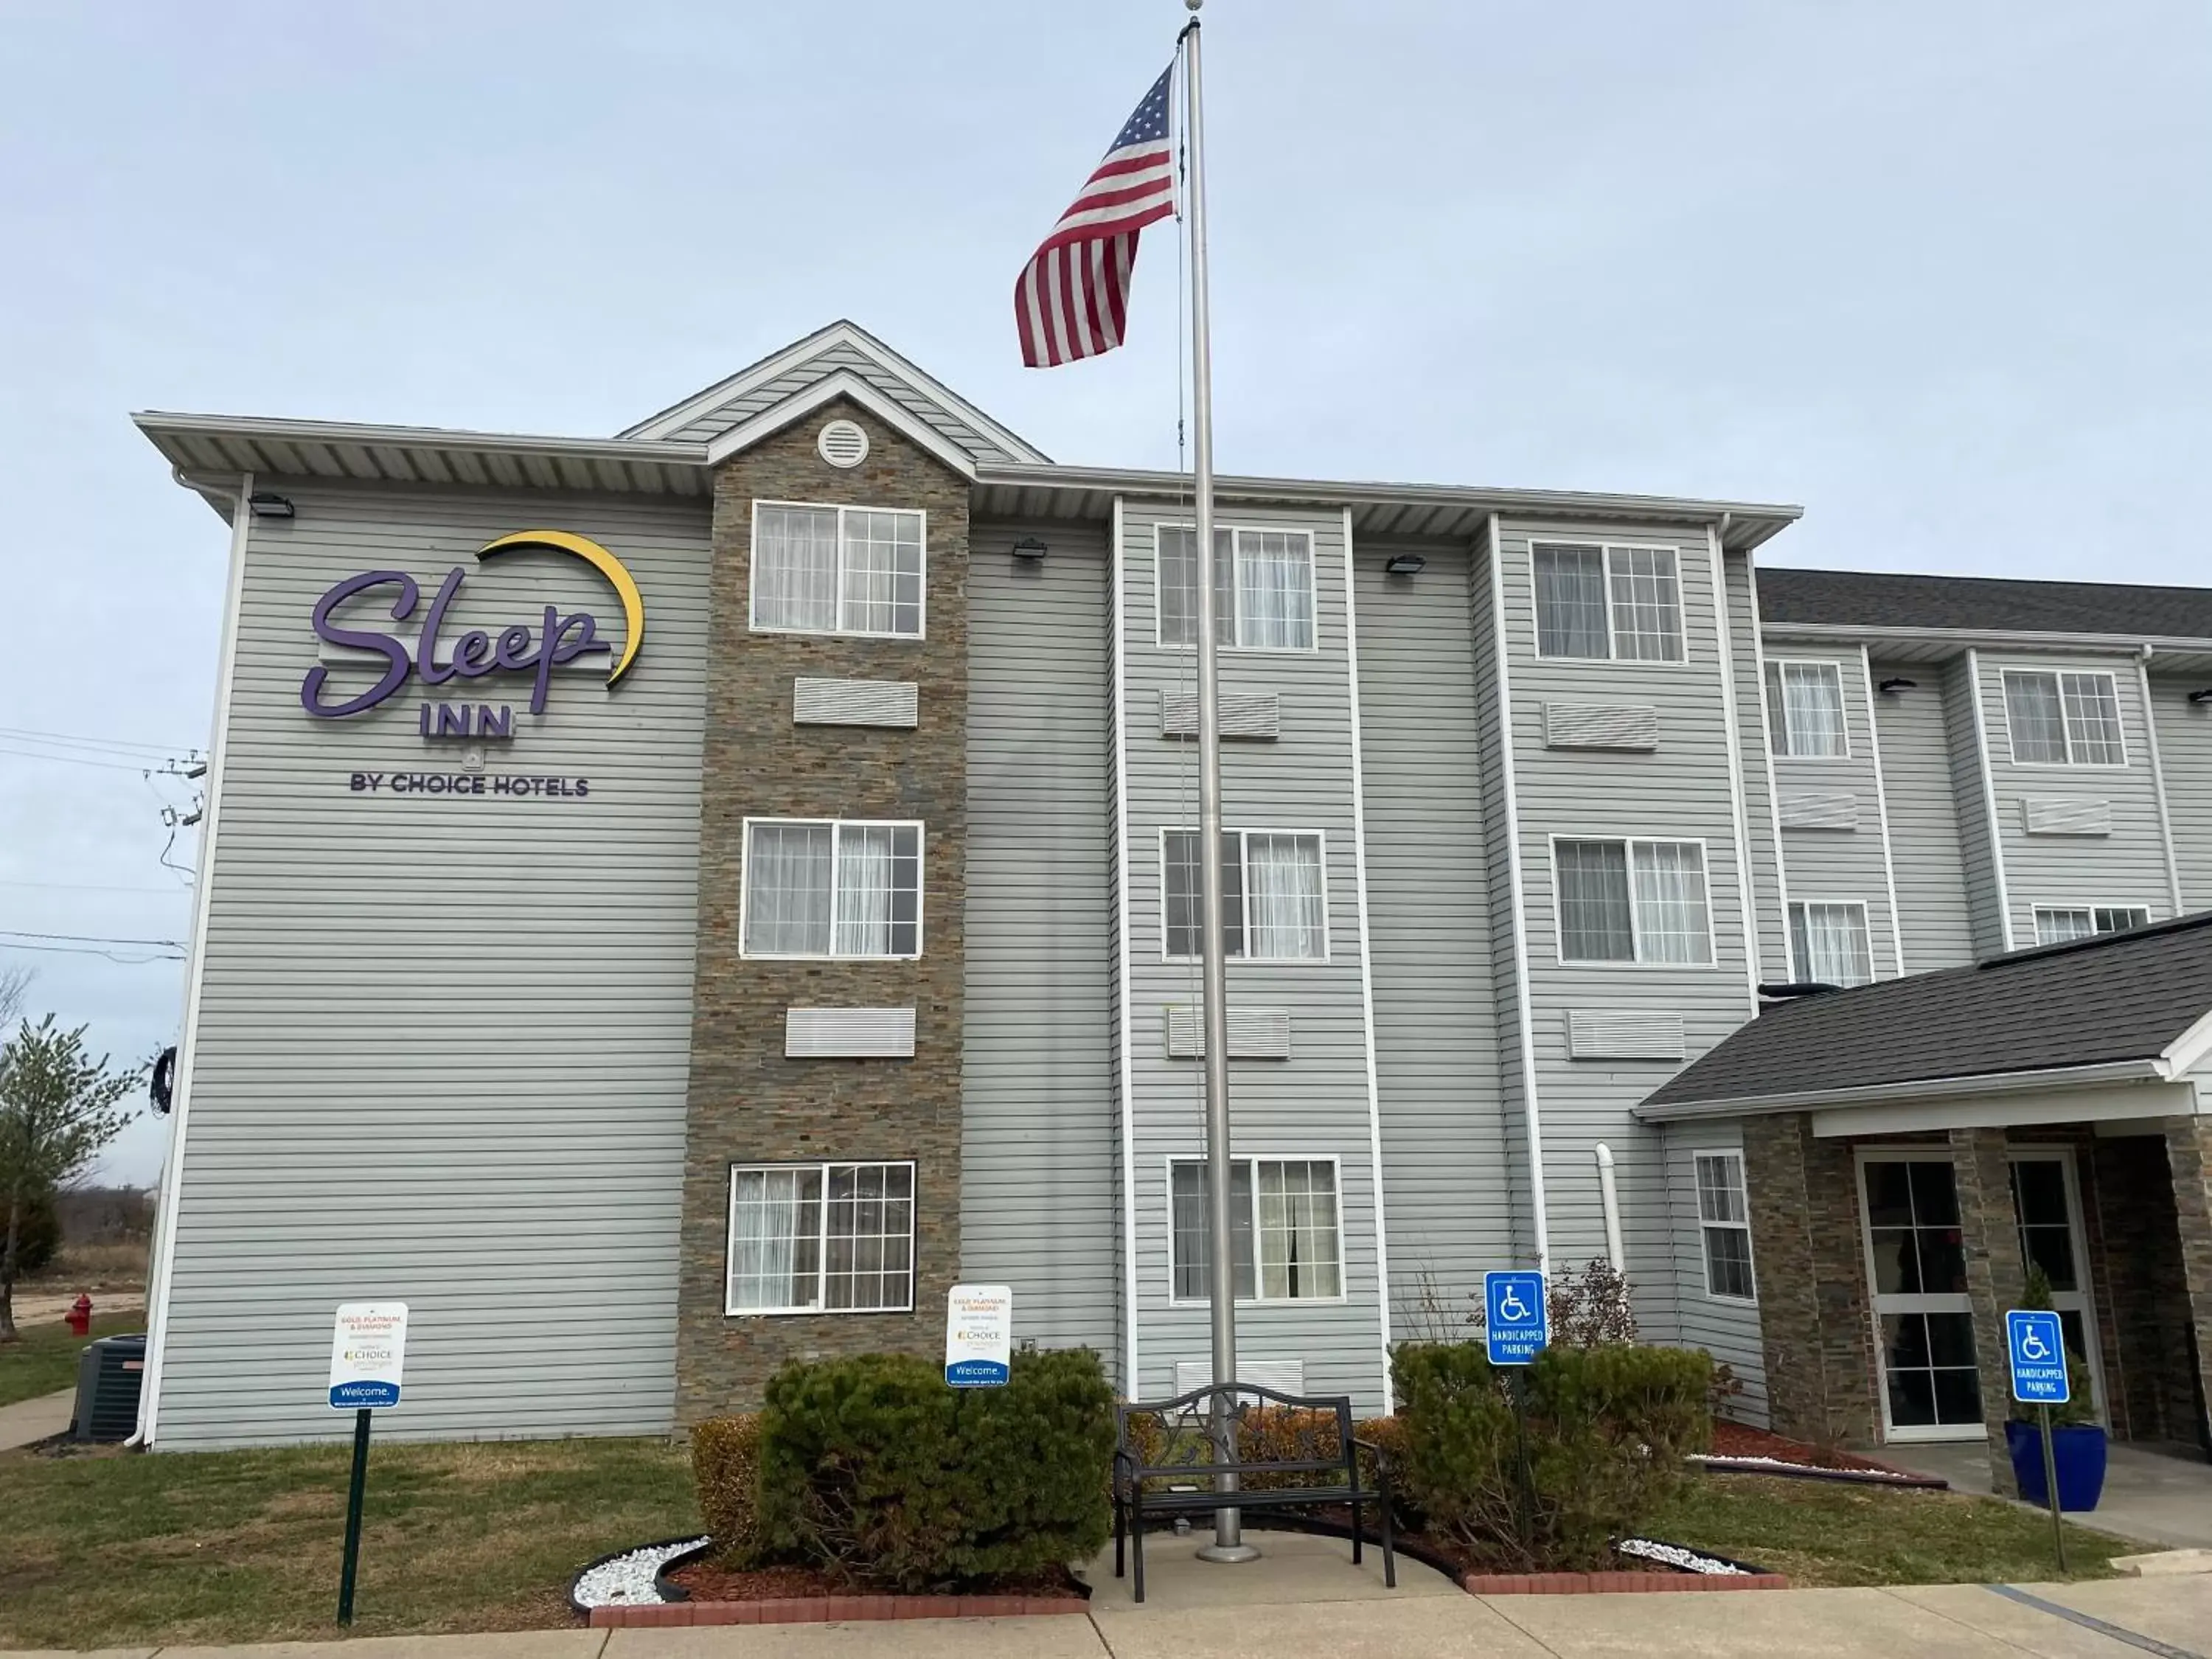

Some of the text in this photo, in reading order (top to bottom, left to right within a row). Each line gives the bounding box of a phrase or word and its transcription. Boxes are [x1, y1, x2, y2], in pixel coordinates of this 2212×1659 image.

[301, 566, 611, 717] Sleep
[420, 703, 512, 737] INN
[350, 773, 588, 796] BY CHOICE HOTELS
[967, 1331, 1001, 1340] CHOICE
[1492, 1329, 1543, 1341] HANDICAPPED
[355, 1350, 392, 1359] CHOICE
[1502, 1344, 1534, 1354] PARKING
[2017, 1368, 2064, 1380] HANDICAPPED
[2026, 1381, 2056, 1393] PARKING
